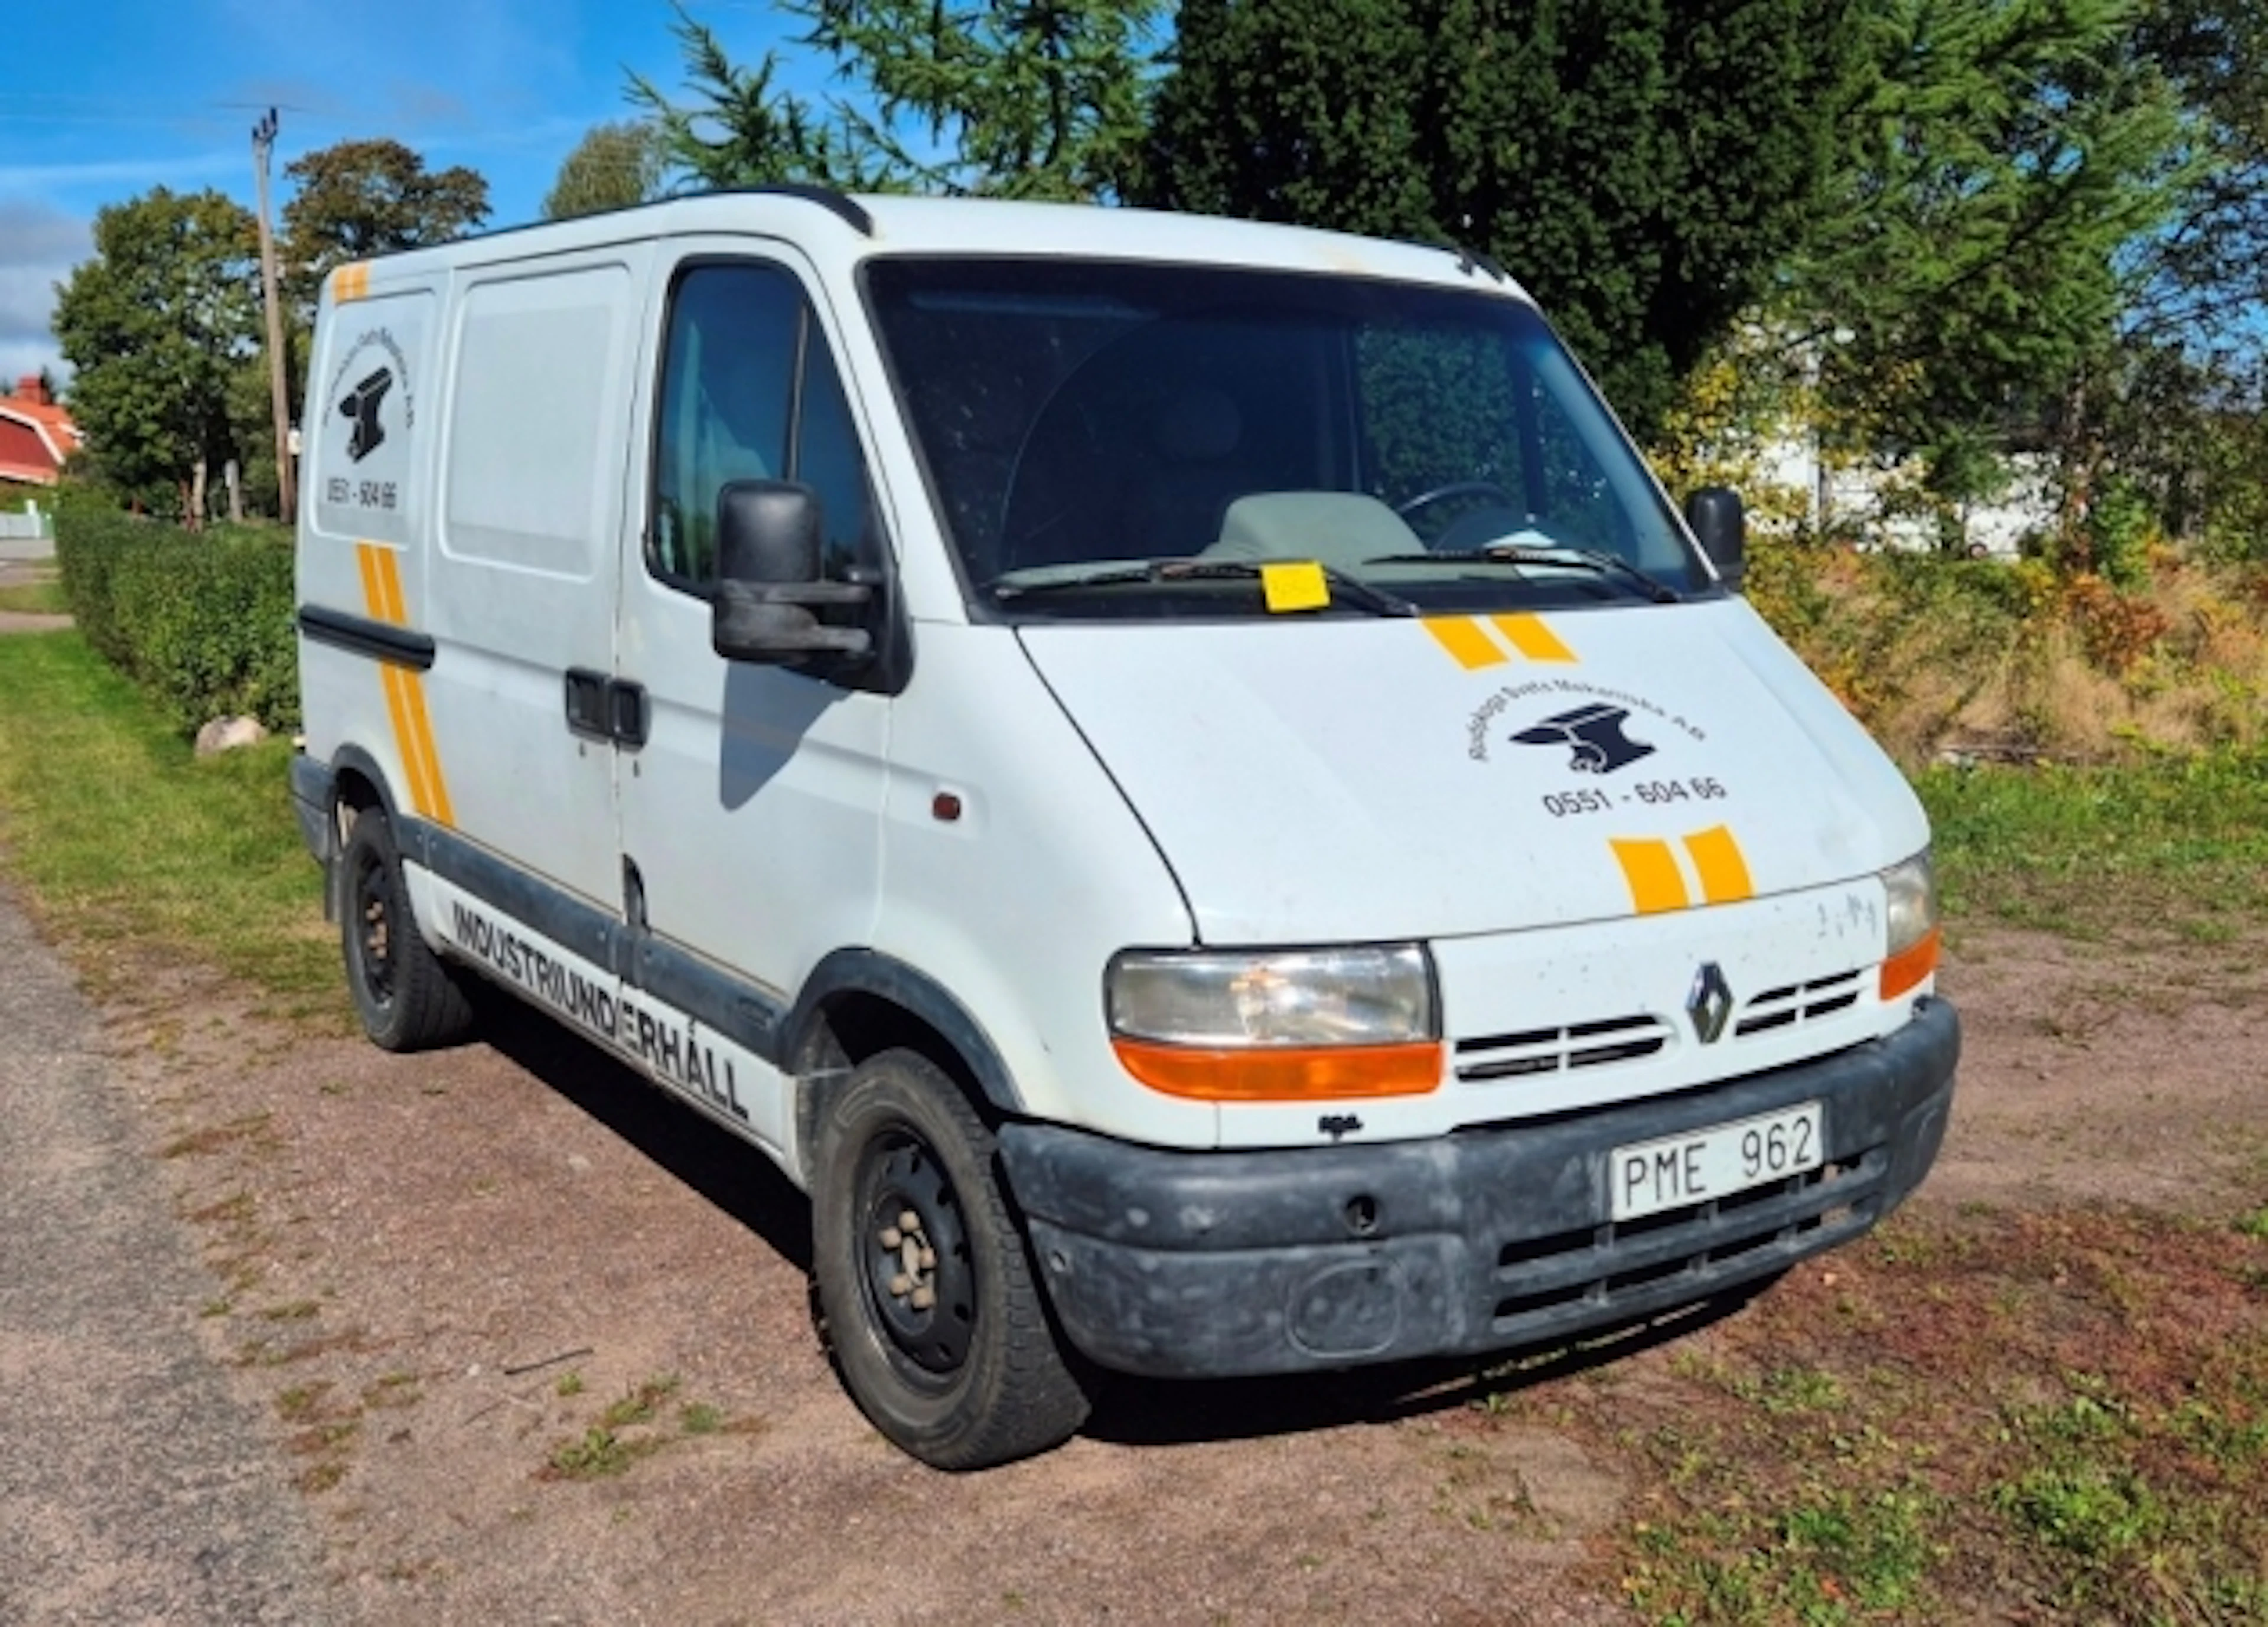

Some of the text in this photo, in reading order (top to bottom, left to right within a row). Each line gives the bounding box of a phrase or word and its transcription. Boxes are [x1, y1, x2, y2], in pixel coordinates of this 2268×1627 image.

[1542, 788, 1613, 817] 0551
[1634, 780, 1689, 804] 604
[1689, 777, 1728, 800] 66
[453, 899, 749, 1121] INDUSTRIUNDERHÅLL
[1626, 1116, 1812, 1209] PME 962
